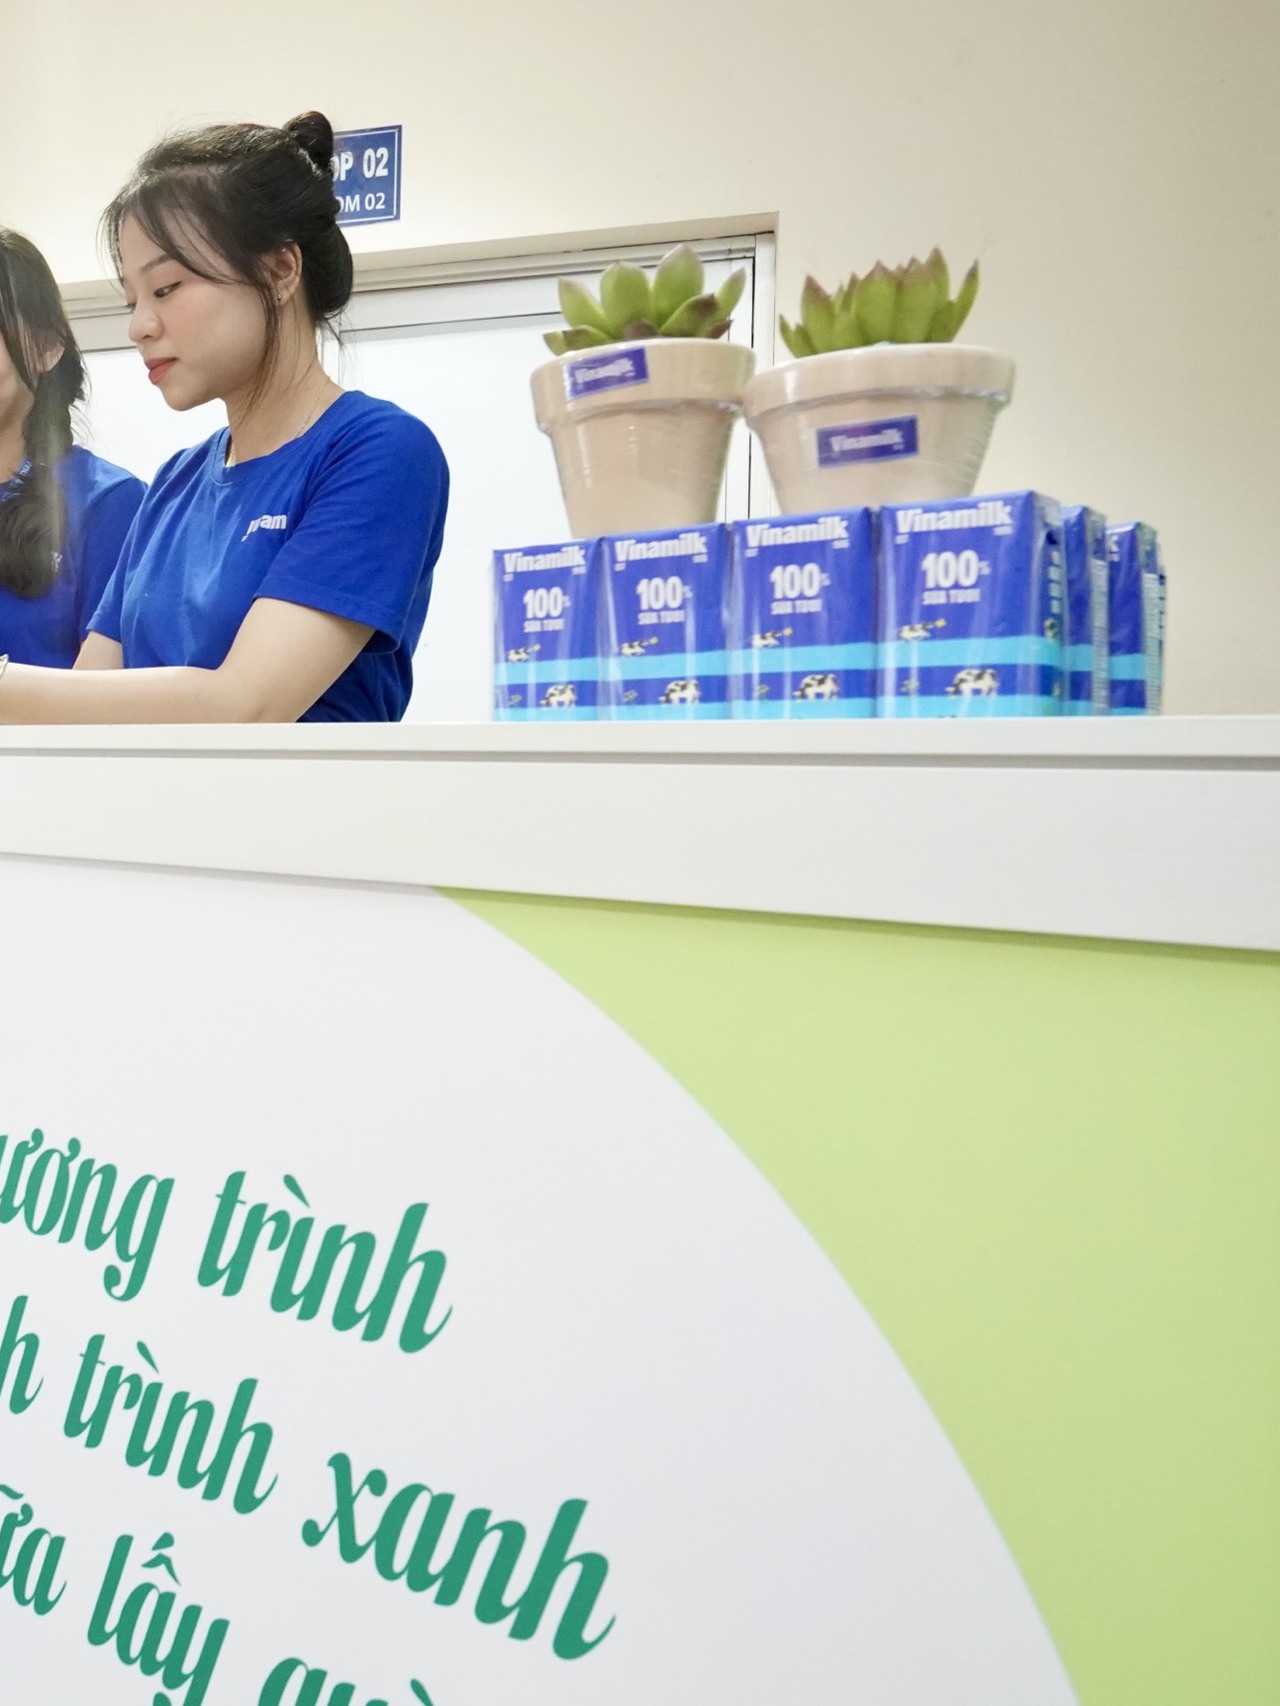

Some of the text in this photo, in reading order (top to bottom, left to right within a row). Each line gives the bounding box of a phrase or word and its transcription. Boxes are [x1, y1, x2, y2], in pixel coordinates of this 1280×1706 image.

[362, 147, 389, 178] 02
[364, 192, 386, 210] 02
[745, 516, 849, 548] Vinamilk
[895, 500, 1013, 534] Vinamilk
[503, 545, 586, 573] Vinamilk
[614, 532, 708, 562] Vinamilk
[196, 1170, 453, 1355] trình
[63, 1333, 278, 1515] trình
[301, 1452, 616, 1661] xanh
[86, 1532, 230, 1706] lấy
